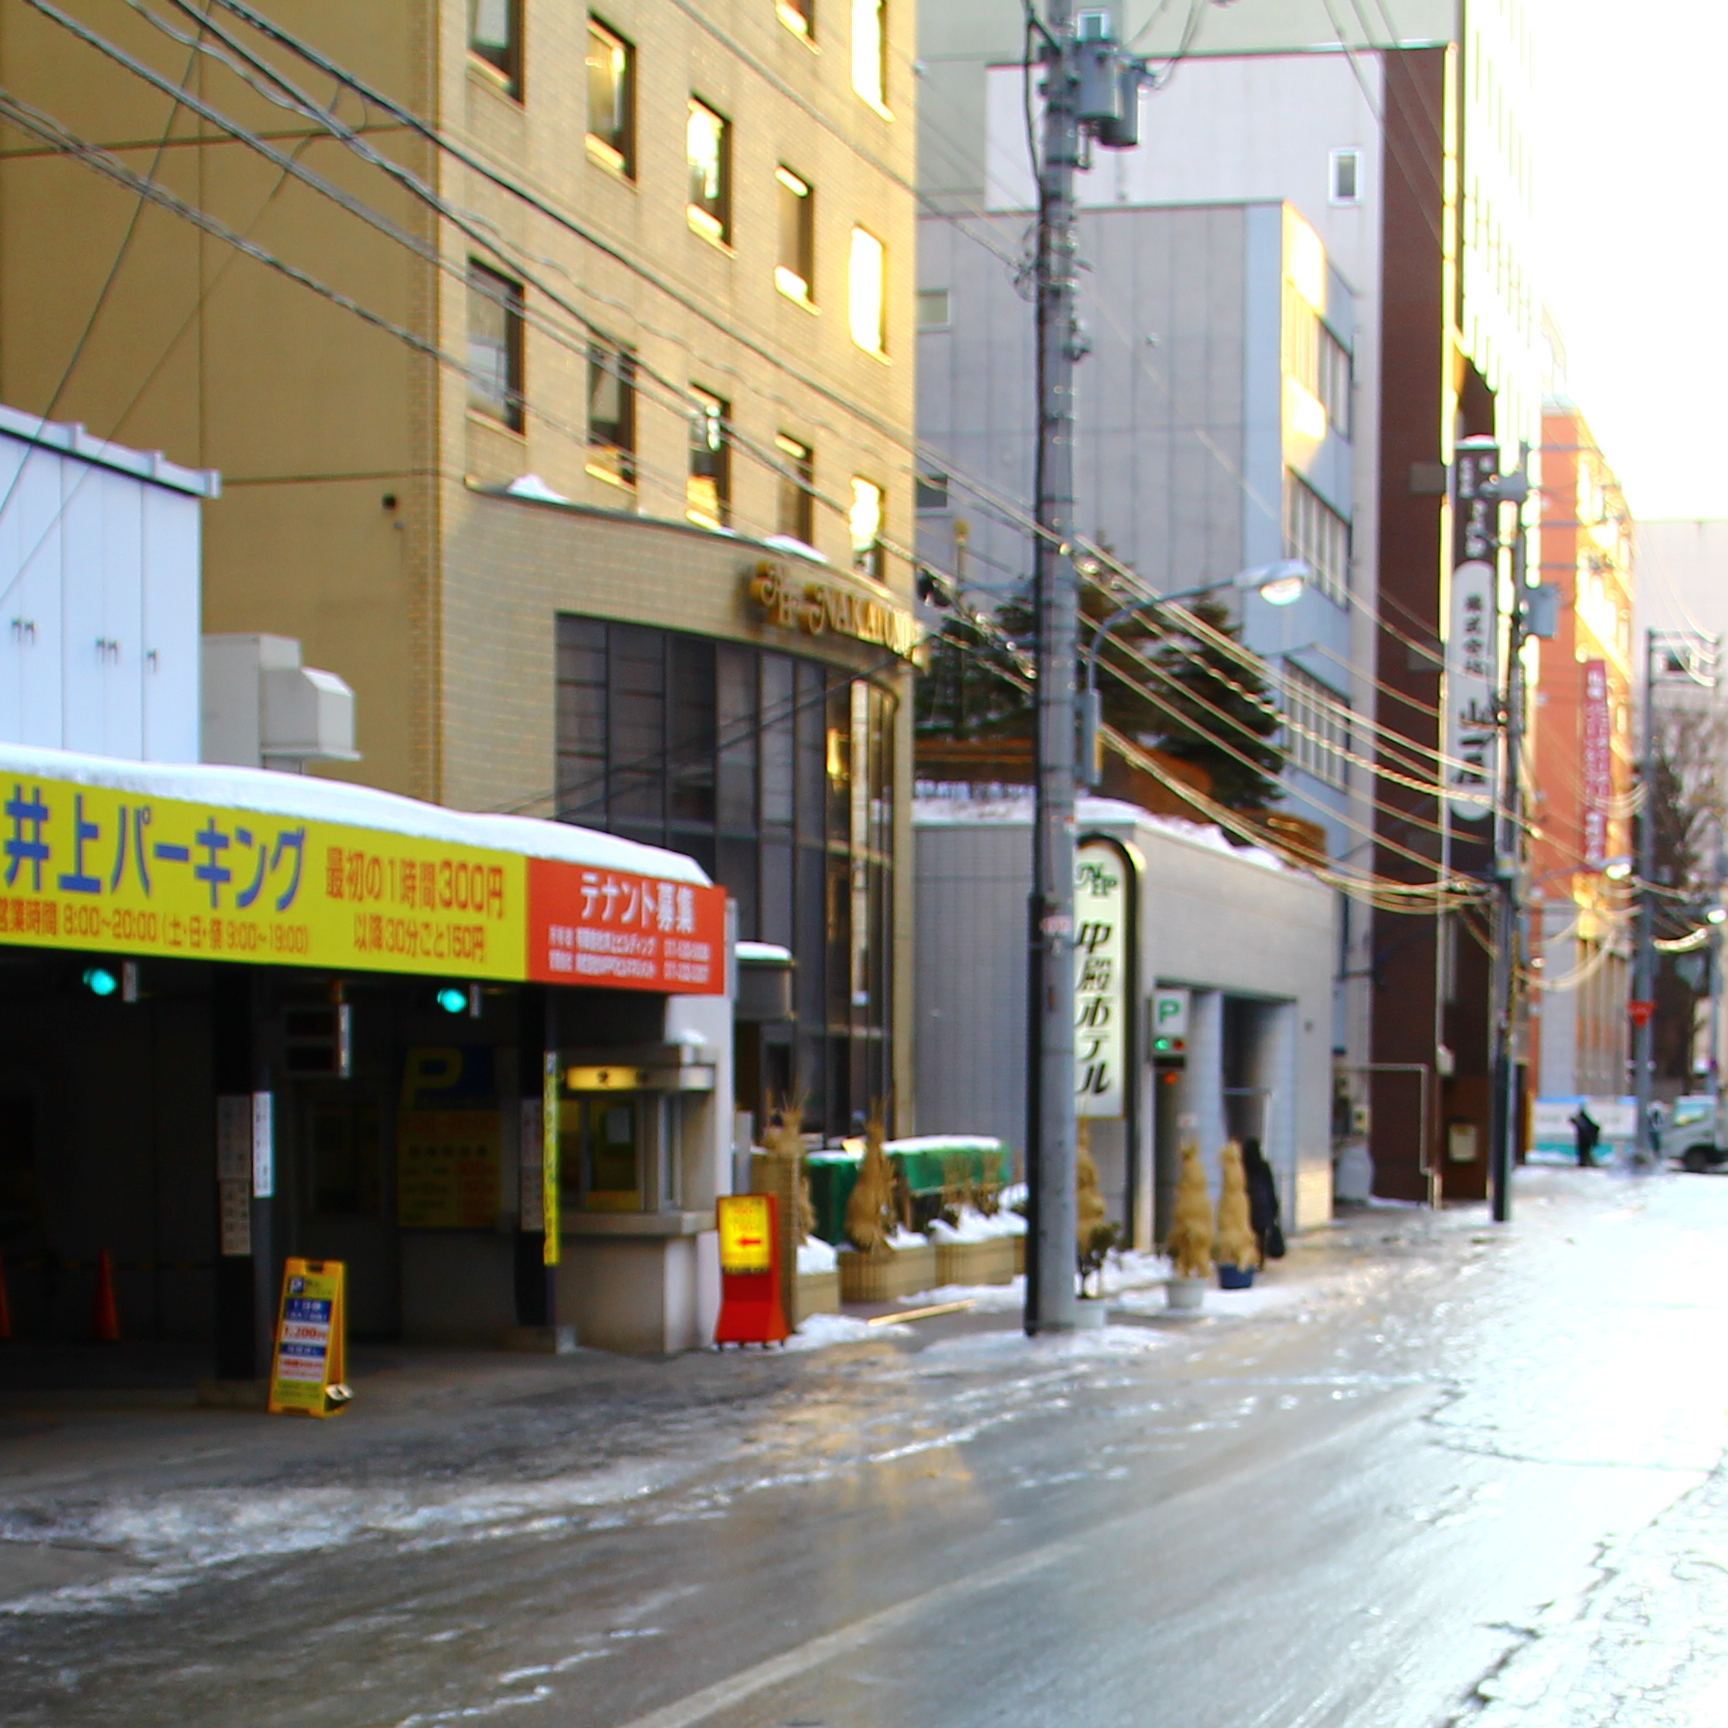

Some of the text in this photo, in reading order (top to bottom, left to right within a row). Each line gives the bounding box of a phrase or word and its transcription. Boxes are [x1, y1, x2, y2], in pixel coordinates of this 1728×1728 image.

[3, 783, 306, 912] 井上パーキング
[580, 872, 695, 933] テナント募集
[1158, 1000, 1182, 1023] P
[400, 1046, 464, 1111] P
